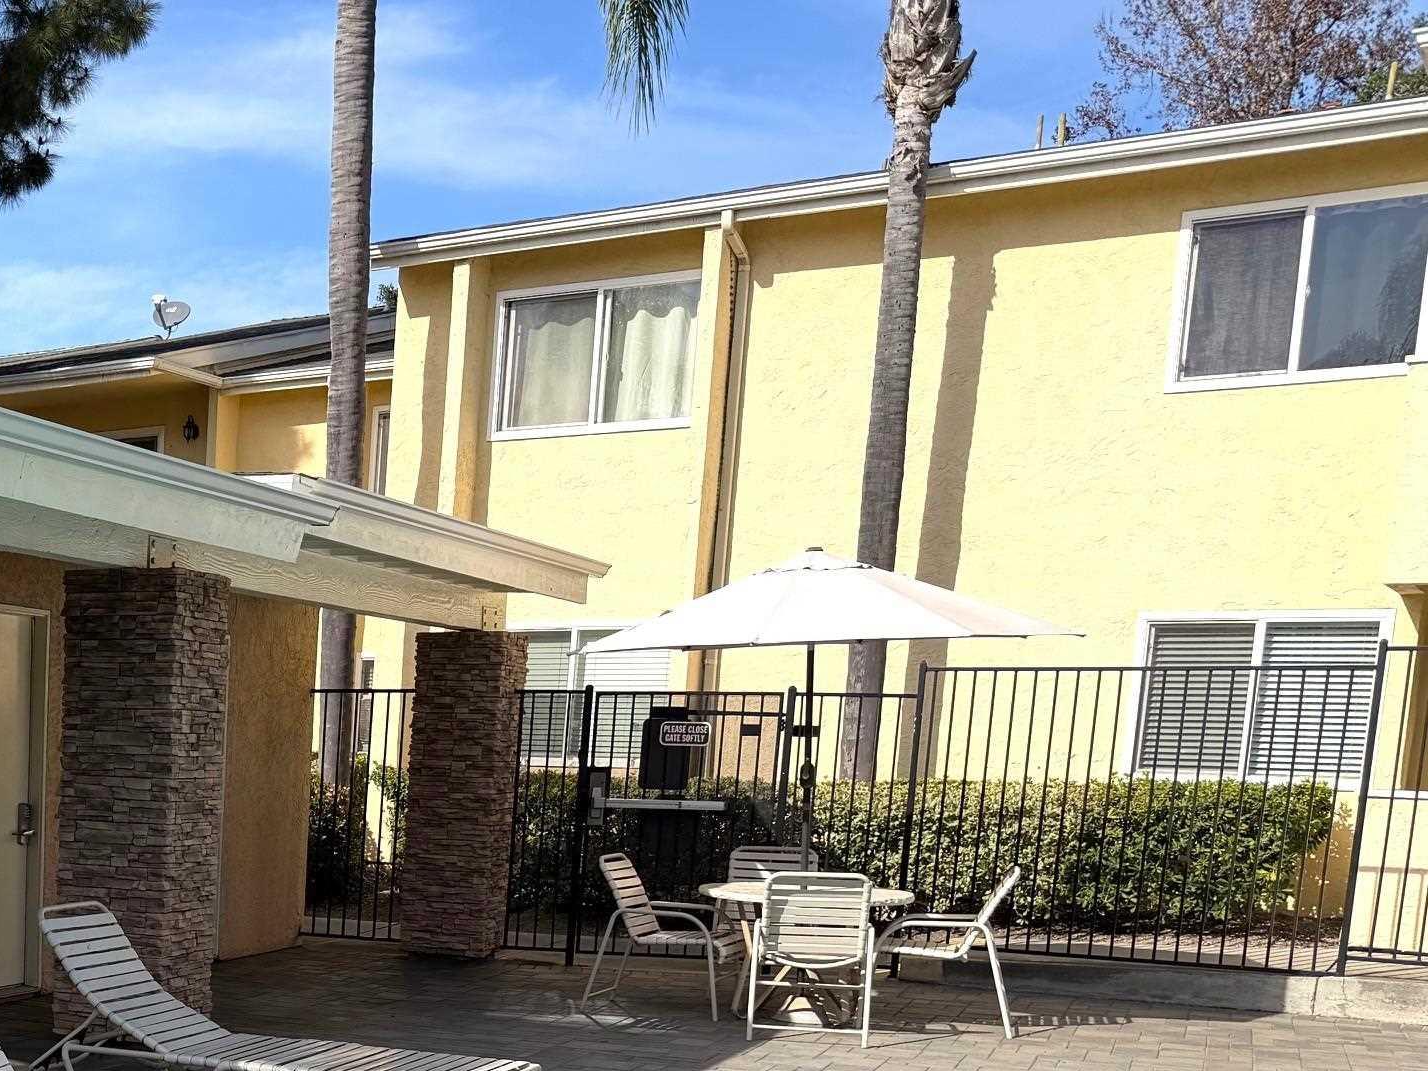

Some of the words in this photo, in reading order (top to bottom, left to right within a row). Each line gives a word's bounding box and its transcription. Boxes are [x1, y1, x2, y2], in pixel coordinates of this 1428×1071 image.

[663, 725, 687, 733] PLEASE
[688, 725, 708, 734] CLOSE
[665, 733, 681, 742] GATE
[682, 734, 705, 743] SOFTLY
